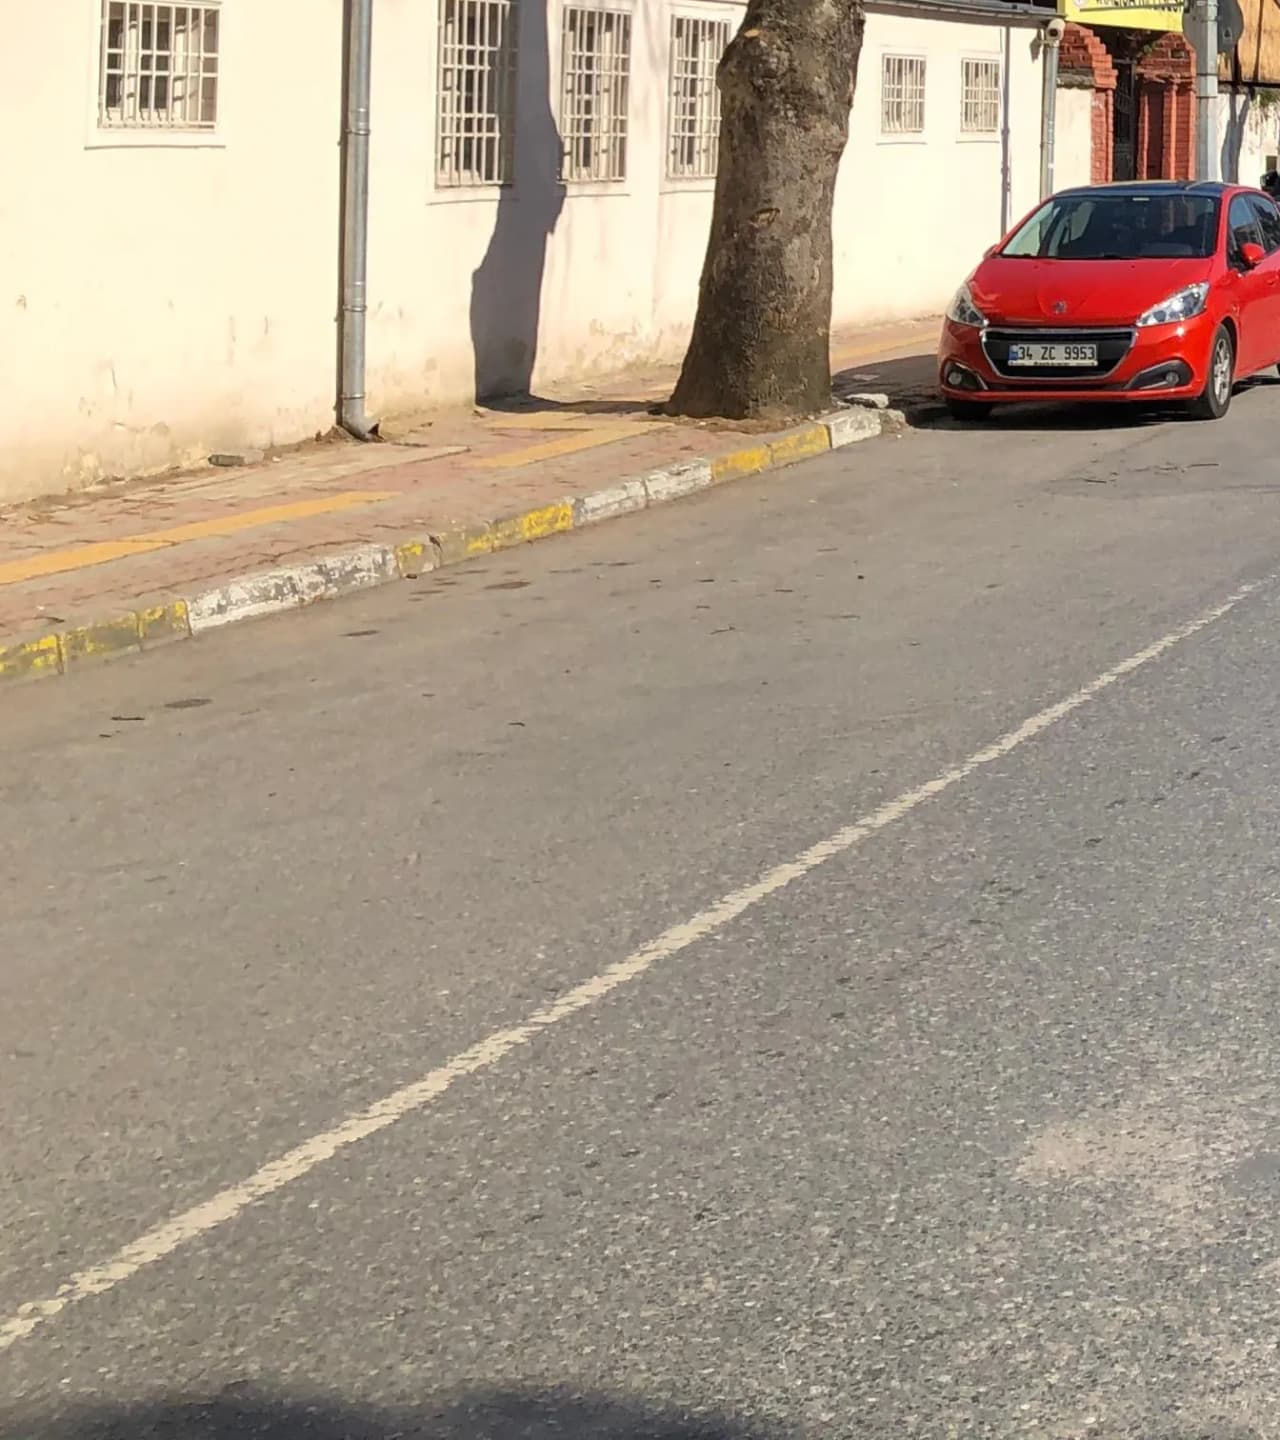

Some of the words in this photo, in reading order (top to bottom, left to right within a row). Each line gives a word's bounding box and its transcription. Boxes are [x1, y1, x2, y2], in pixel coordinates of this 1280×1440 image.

[1018, 346, 1033, 361] 34
[1041, 346, 1056, 360] ZC
[1064, 346, 1096, 360] 9953
